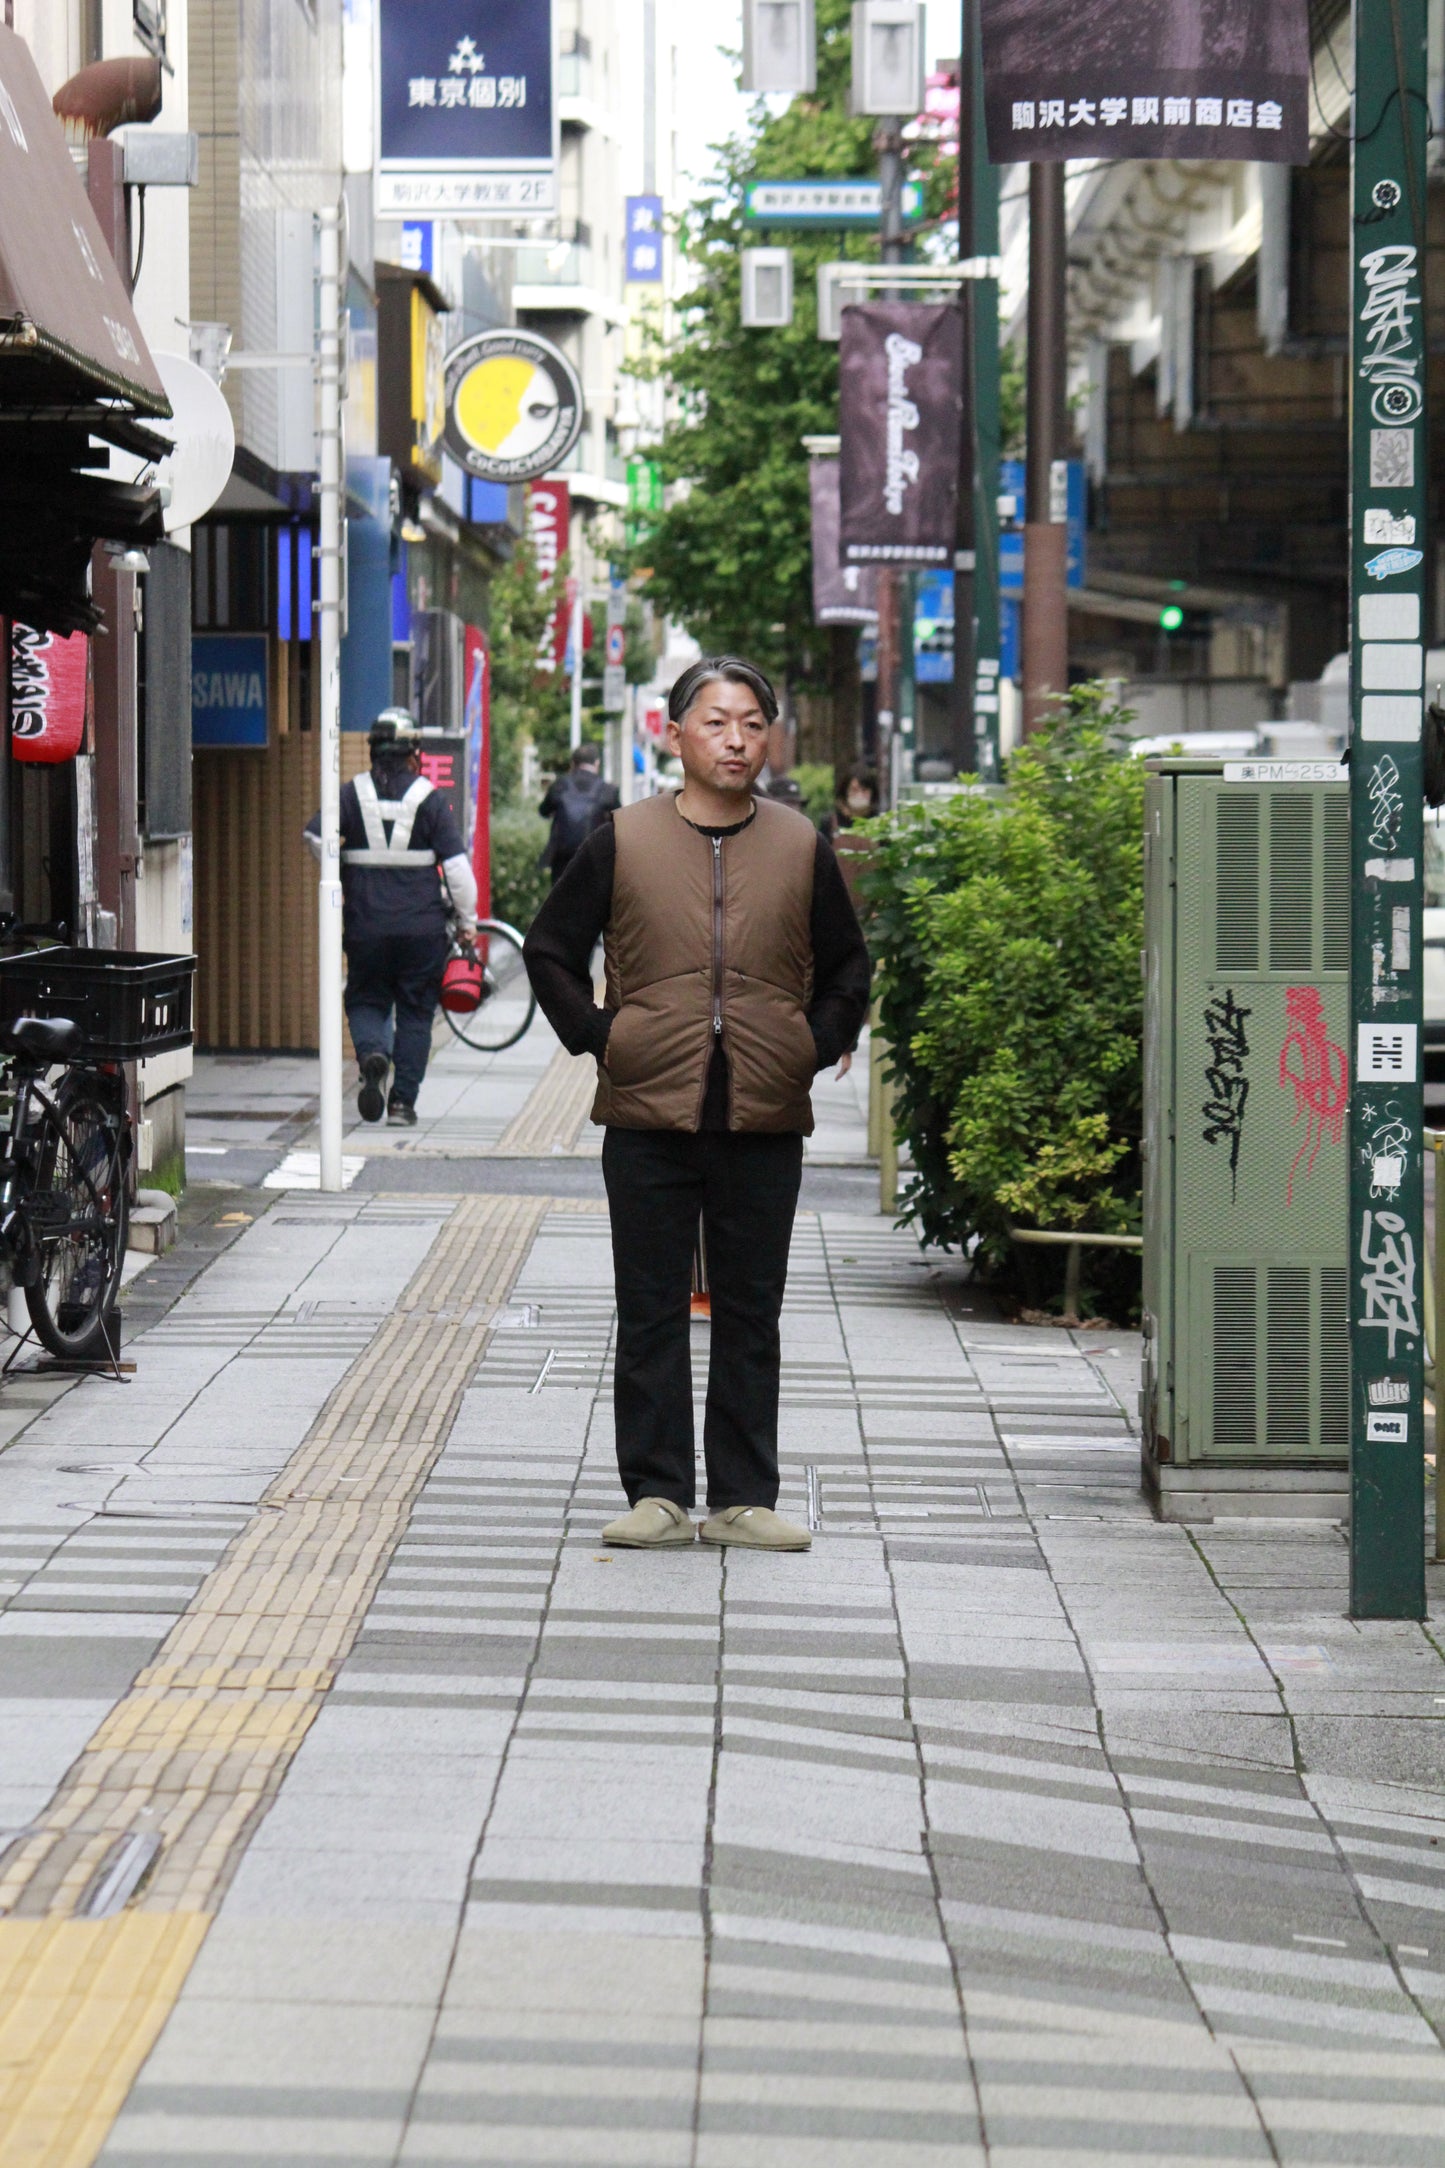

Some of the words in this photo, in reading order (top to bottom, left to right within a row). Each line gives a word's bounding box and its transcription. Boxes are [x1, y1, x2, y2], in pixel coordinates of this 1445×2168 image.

[408, 76, 526, 108] 東京個別
[1012, 97, 1283, 130] 駒沢大学駅前商店会
[520, 180, 547, 202] 2F
[191, 671, 263, 708] SAWA
